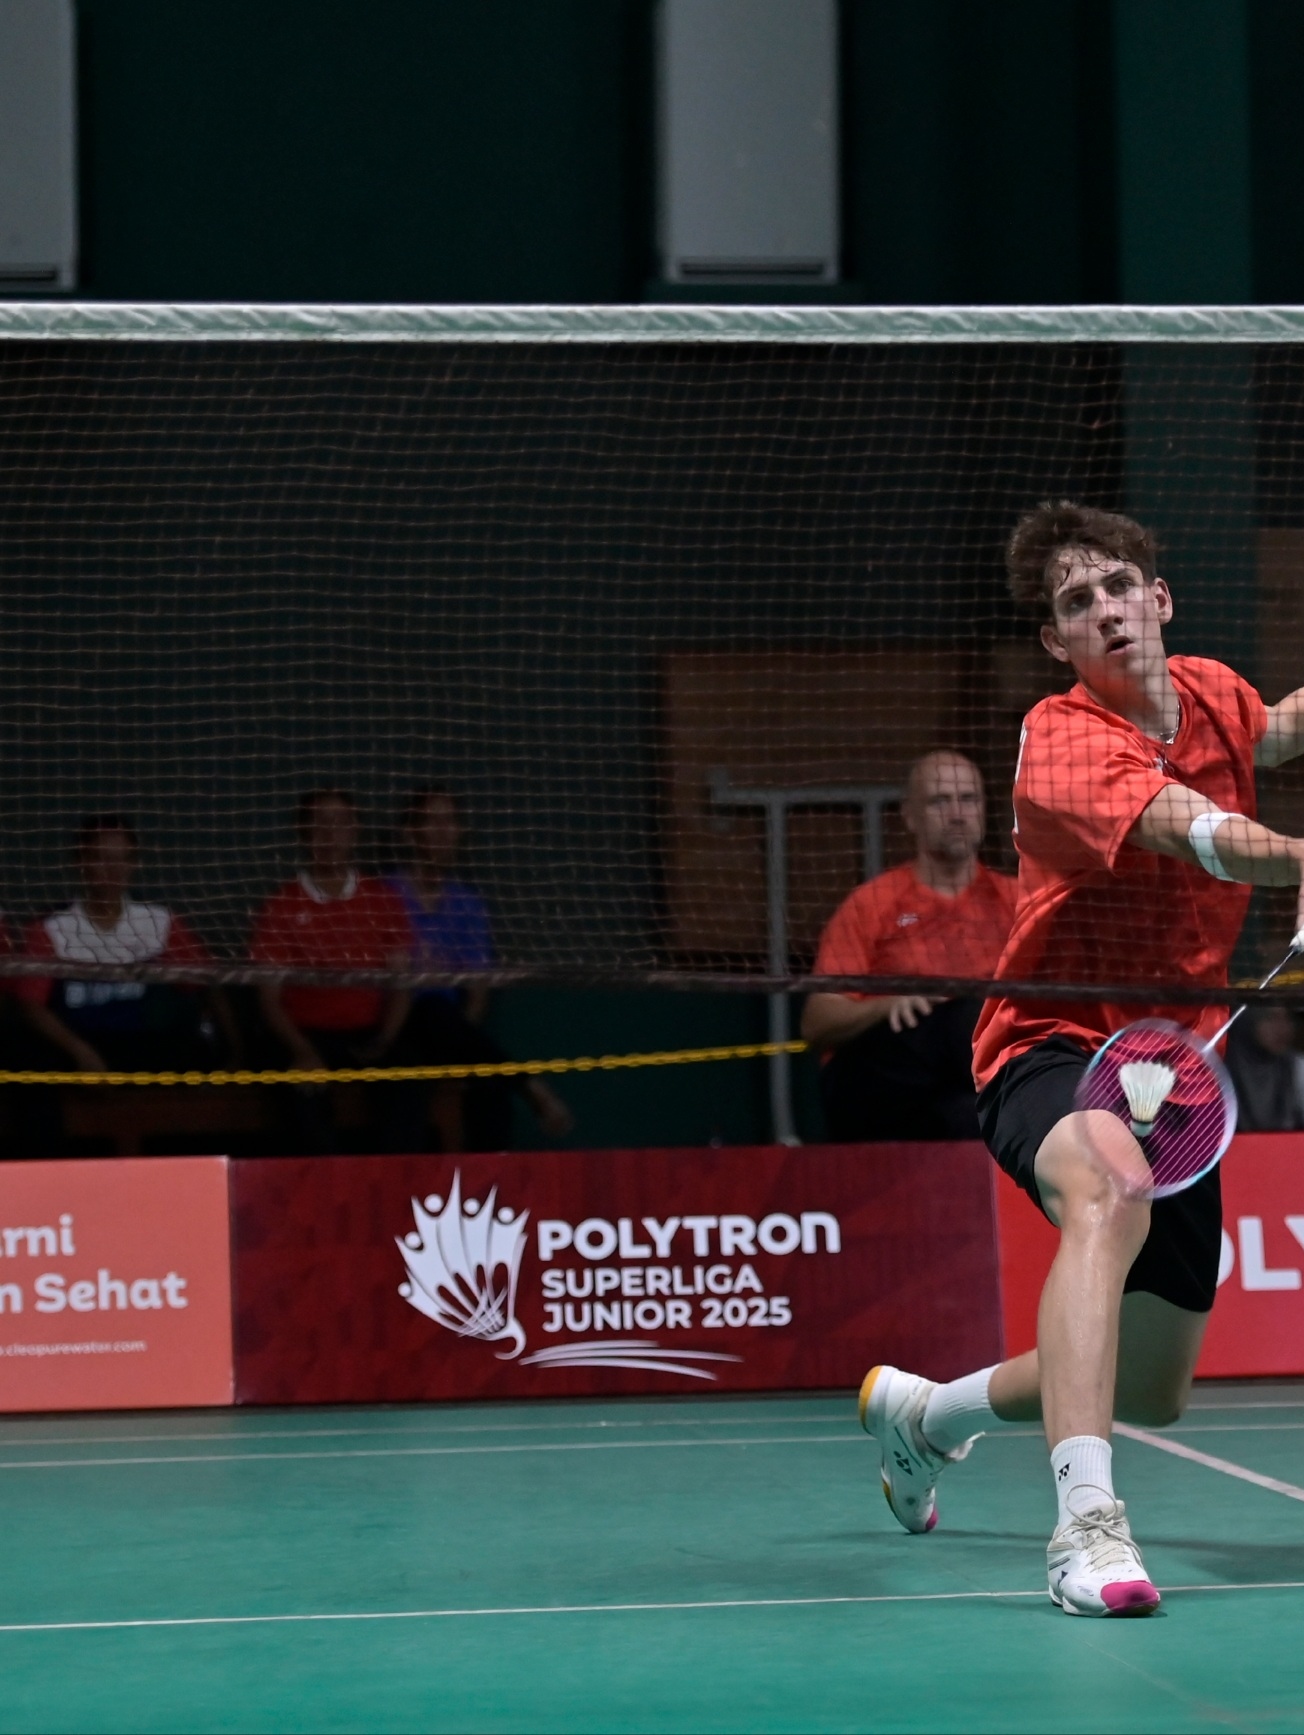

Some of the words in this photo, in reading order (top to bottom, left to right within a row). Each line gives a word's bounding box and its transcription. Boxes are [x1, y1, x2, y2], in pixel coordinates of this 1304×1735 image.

[0, 1213, 75, 1257] rni
[34, 1268, 189, 1313] Sehat
[541, 1263, 764, 1299] SUPERLIGA
[542, 1299, 693, 1333] JUNIOR
[699, 1296, 793, 1328] 2025
